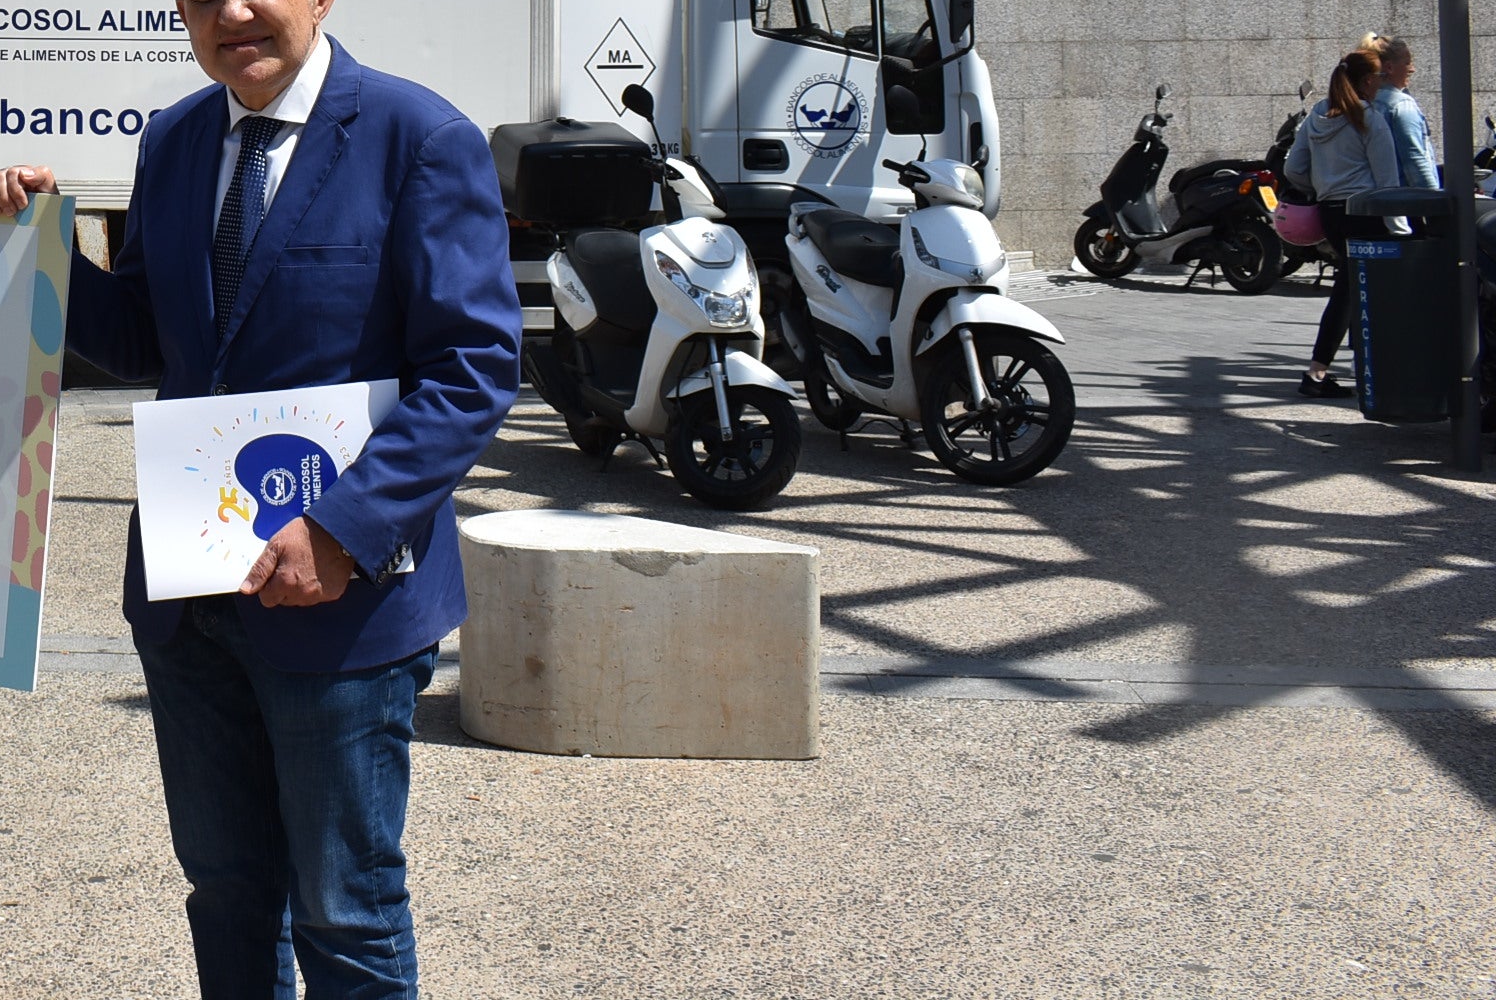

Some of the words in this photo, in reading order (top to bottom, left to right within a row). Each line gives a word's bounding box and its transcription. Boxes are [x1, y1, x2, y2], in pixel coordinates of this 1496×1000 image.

[98, 9, 186, 32] ALIME
[12, 49, 96, 62] ALIMENTOS
[101, 50, 120, 62] DE
[124, 50, 143, 62] LA
[147, 50, 195, 63] COSTA
[608, 50, 632, 63] MA
[786, 77, 813, 113] BANCOS
[667, 143, 679, 154] KG
[1358, 272, 1372, 396] GRACIAS
[224, 459, 232, 485] AÑOS
[311, 453, 322, 500] IMENTOS
[217, 486, 251, 523] 25
